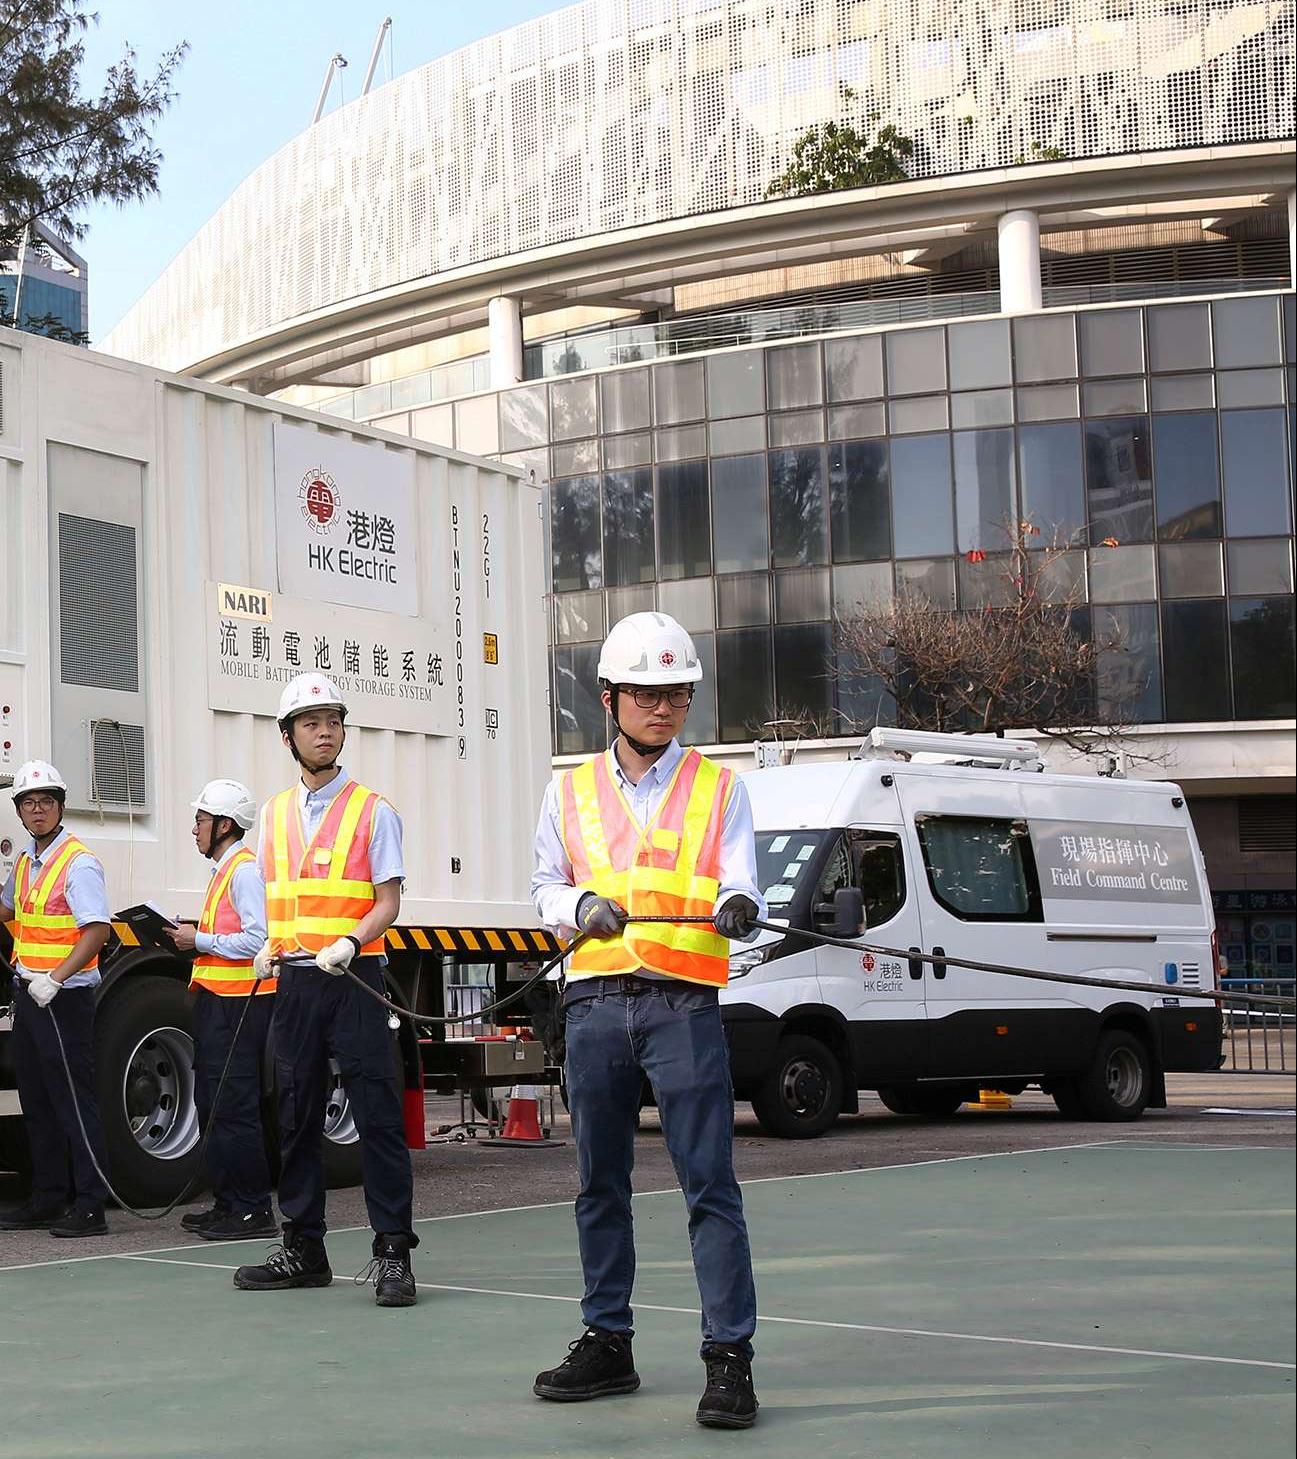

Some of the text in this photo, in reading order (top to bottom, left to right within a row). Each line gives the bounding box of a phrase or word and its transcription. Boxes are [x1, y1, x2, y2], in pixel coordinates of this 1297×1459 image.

[346, 510, 397, 555] 港燈
[308, 543, 397, 584] HK Electric
[224, 590, 267, 616] NARI
[221, 659, 259, 679] MOBILE
[265, 665, 307, 683] BATTE
[355, 678, 396, 697] STORAGE
[398, 683, 432, 702] SYSTEM
[486, 728, 496, 740] 70
[1059, 835, 1169, 867] 現場指揮中心
[1050, 867, 1189, 891] Field Command Centre
[864, 980, 903, 992] HK Electric
